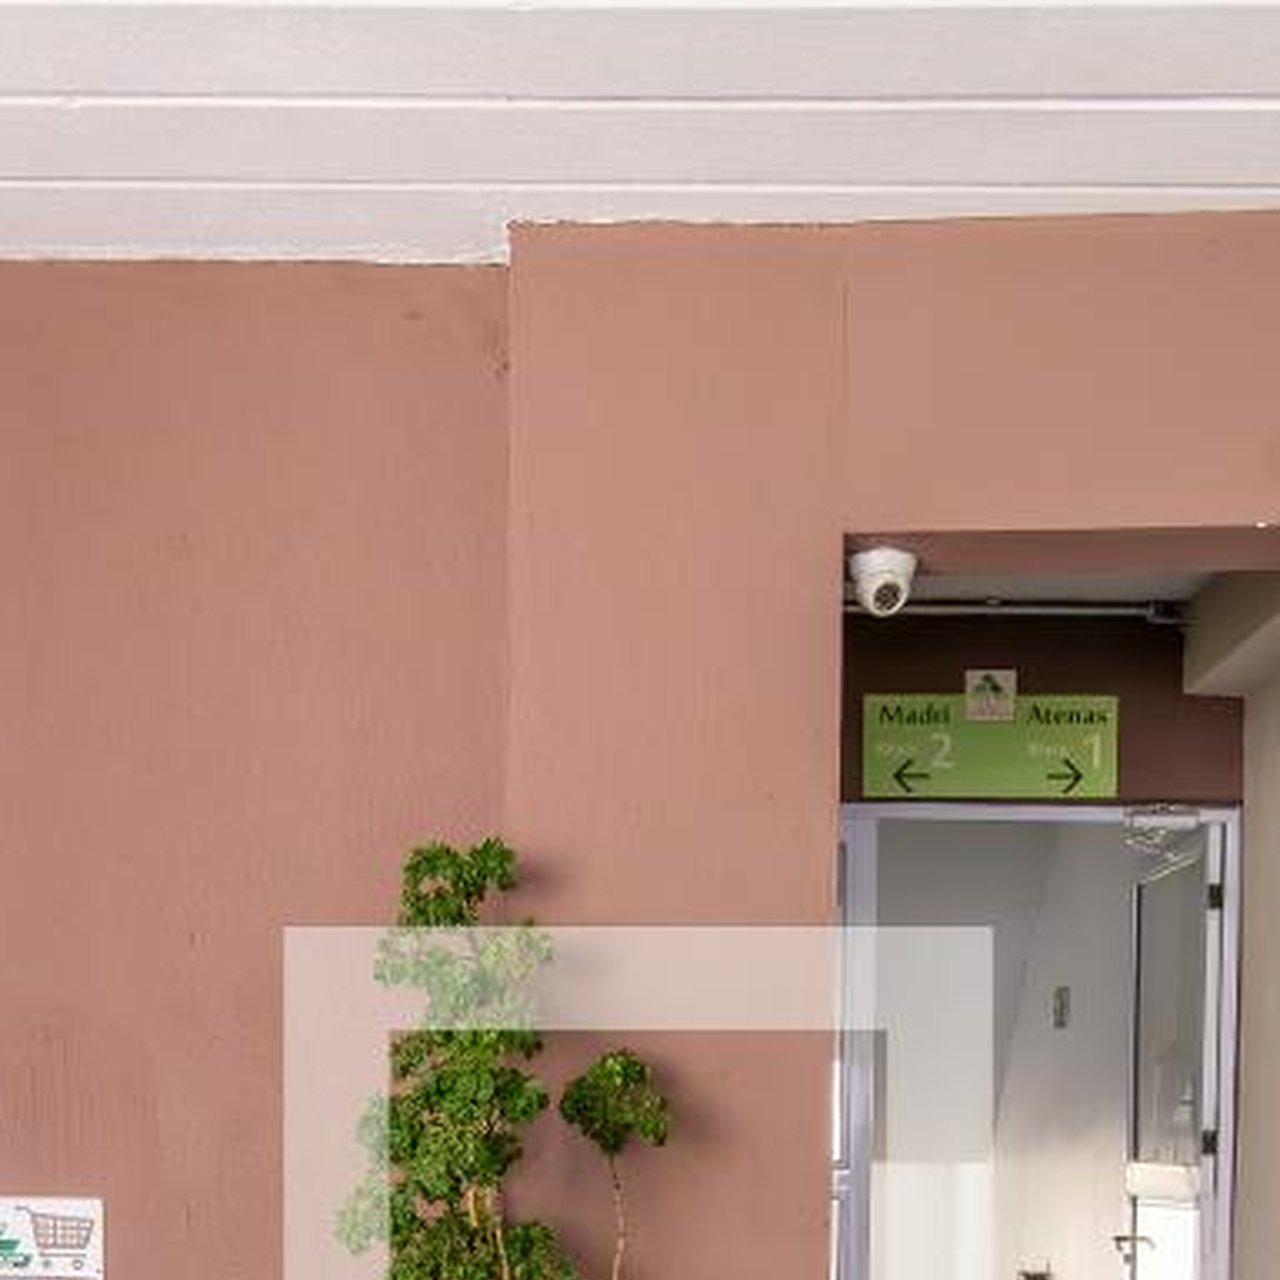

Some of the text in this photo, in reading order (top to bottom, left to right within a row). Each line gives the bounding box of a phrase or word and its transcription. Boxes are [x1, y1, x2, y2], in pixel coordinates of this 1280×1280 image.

[878, 703, 951, 725] Madri
[1026, 703, 1108, 726] Atenas
[931, 732, 956, 769] 2
[1084, 732, 1101, 769] 1
